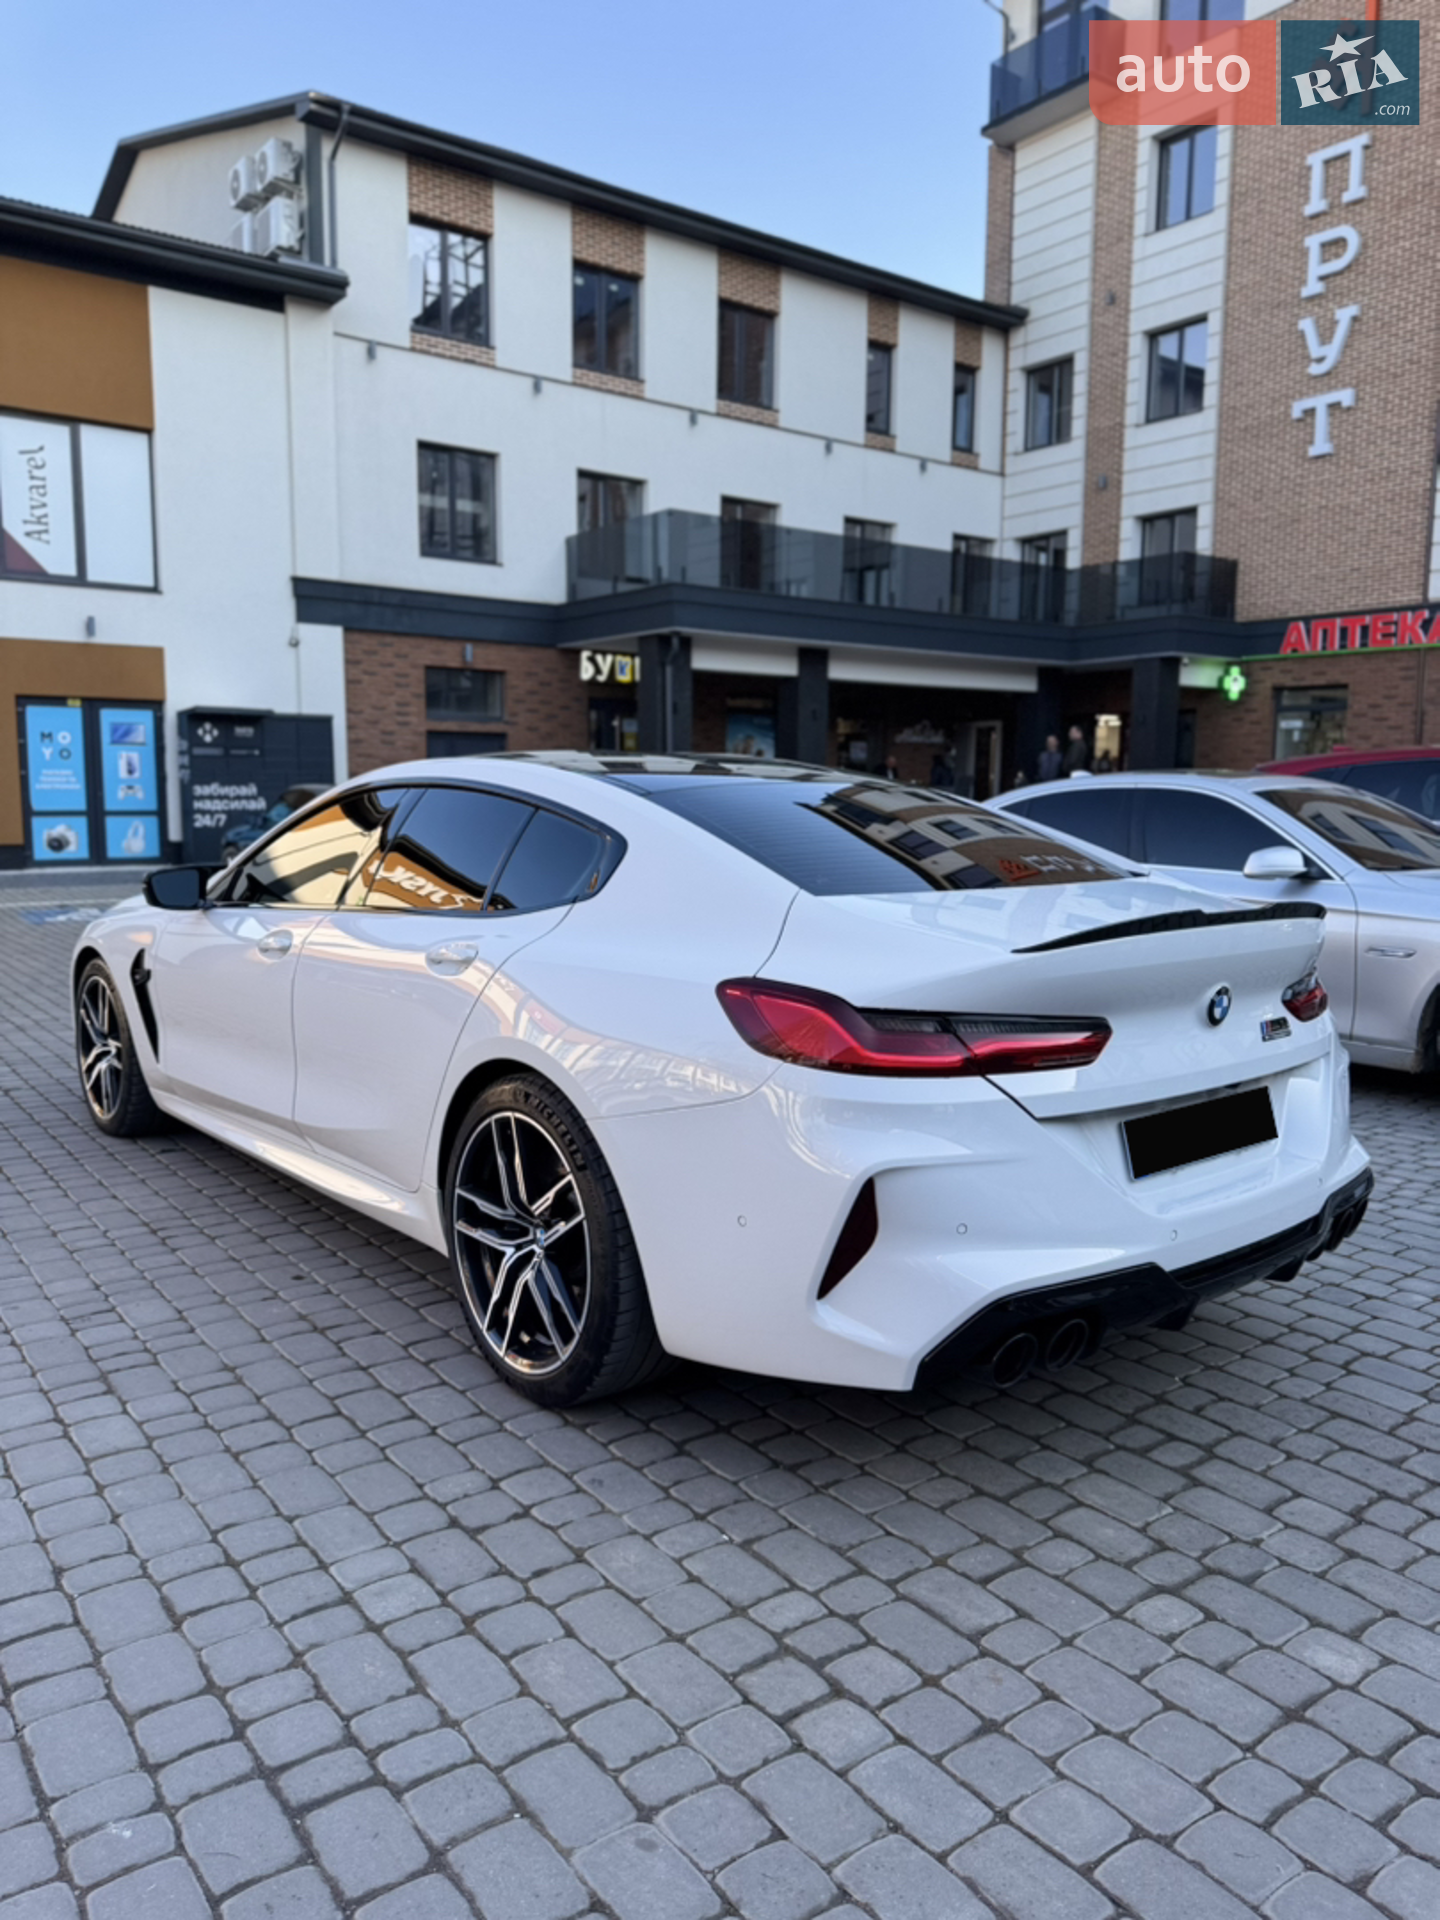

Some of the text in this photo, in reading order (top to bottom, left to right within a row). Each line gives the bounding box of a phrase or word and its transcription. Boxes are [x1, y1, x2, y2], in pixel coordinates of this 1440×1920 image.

[1292, 132, 1371, 457] ПРУТ
[18, 445, 50, 545] Akvarel
[193, 782, 258, 798] забирай
[193, 797, 266, 811] надсилай
[193, 814, 227, 827] 24/7
[526, 1093, 586, 1168] MICHELIN
